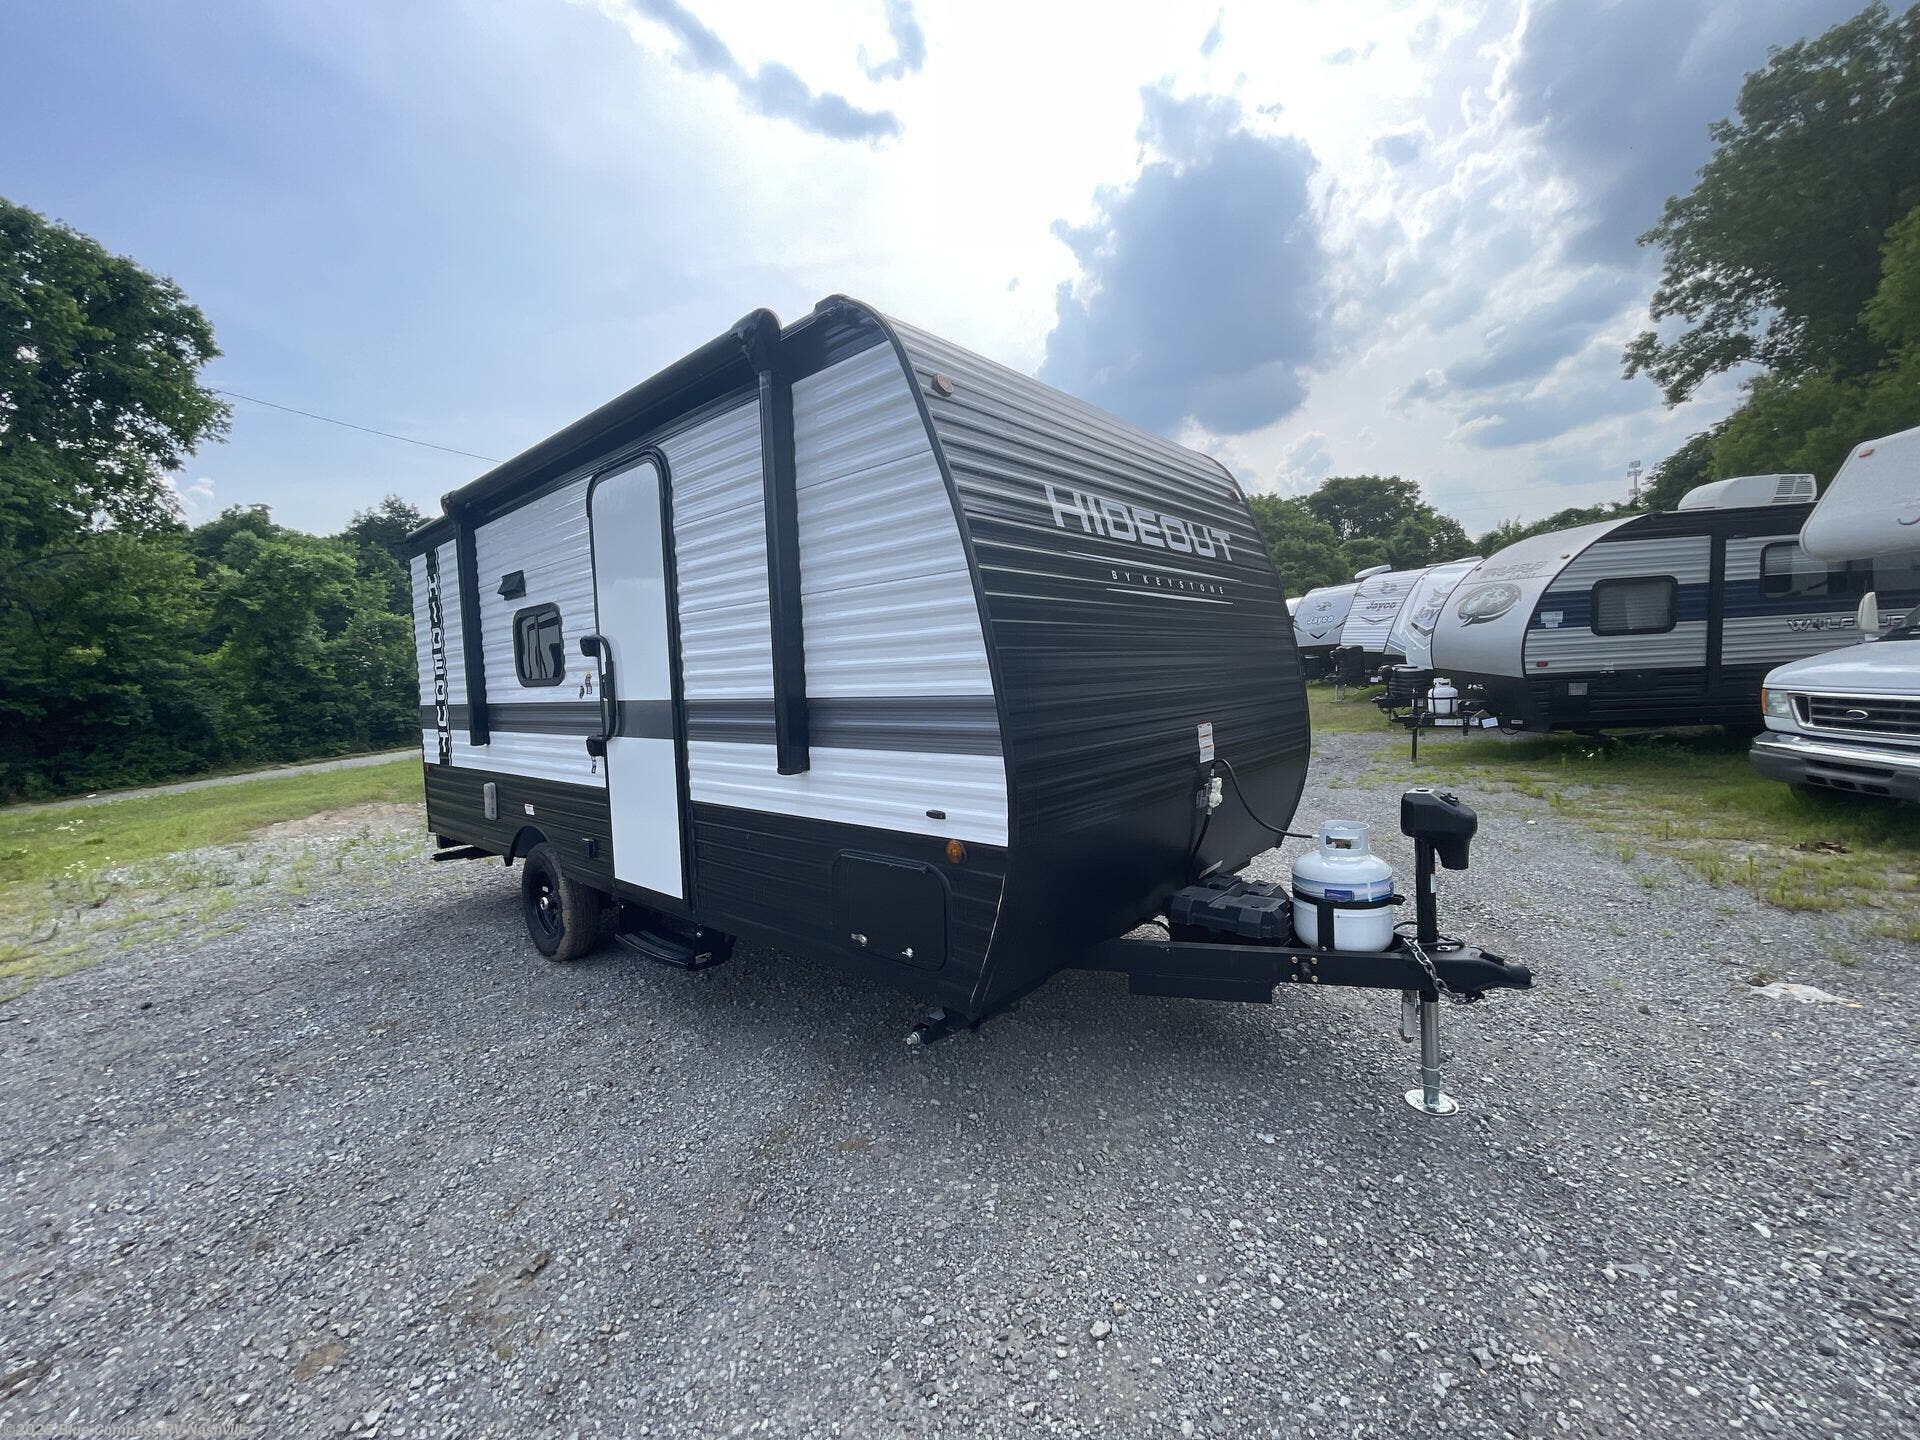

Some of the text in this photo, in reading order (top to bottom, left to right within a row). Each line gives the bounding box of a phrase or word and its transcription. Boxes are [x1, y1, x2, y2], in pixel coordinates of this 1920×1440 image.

[1044, 483, 1233, 561] HIDEOUT
[1111, 569, 1224, 594] BY KEYSTONE
[1366, 600, 1398, 611] Jayco
[1306, 614, 1334, 625] Jayco
[427, 574, 449, 753] HIDEOUT
